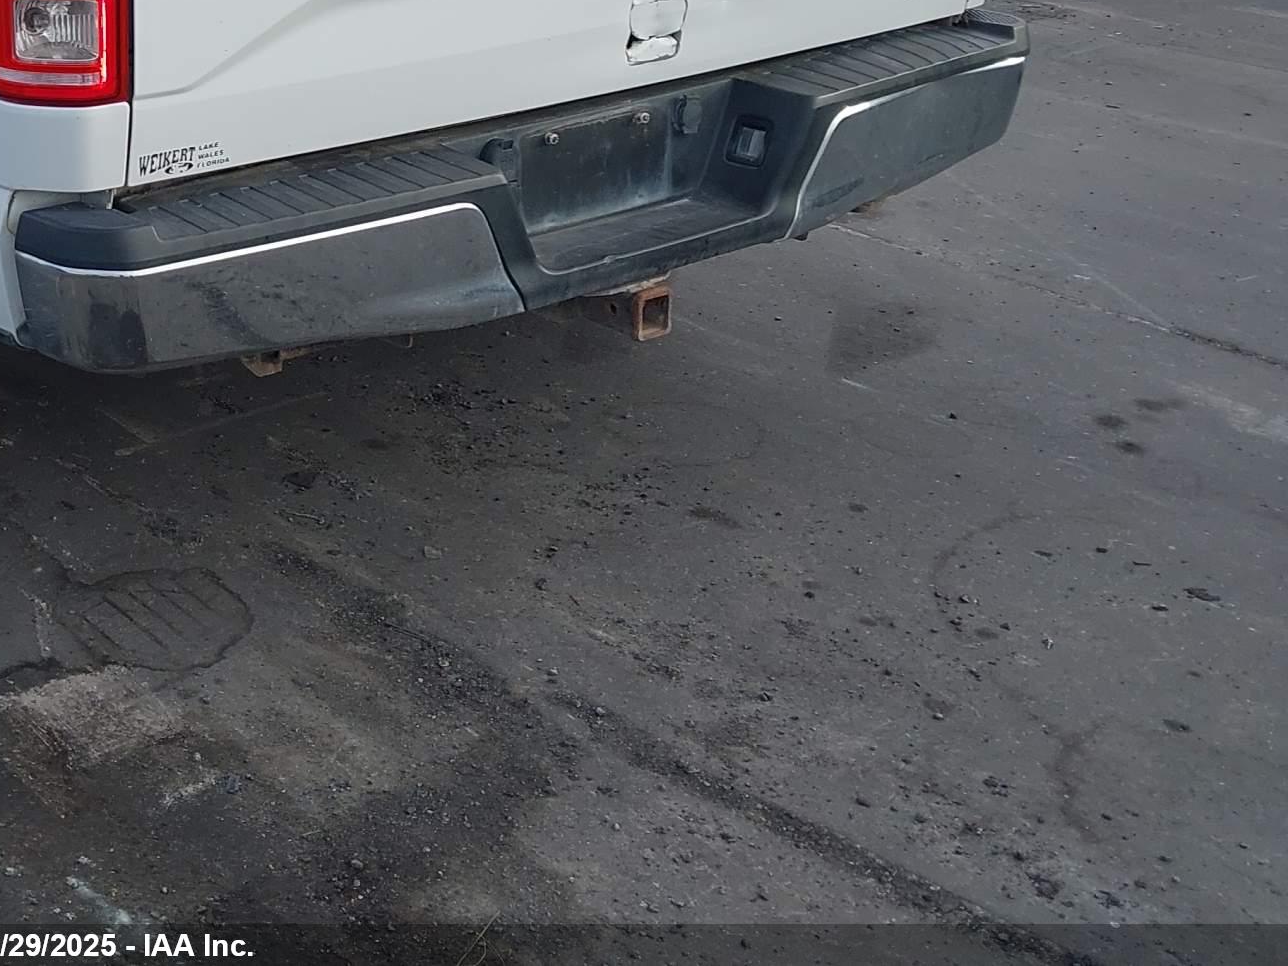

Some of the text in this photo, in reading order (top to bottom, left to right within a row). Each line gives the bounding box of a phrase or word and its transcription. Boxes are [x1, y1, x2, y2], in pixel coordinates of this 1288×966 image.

[198, 141, 220, 151] LAKE
[197, 149, 224, 160] WALES
[138, 146, 196, 177] WEIKERT
[196, 157, 230, 169] FLORIDA
